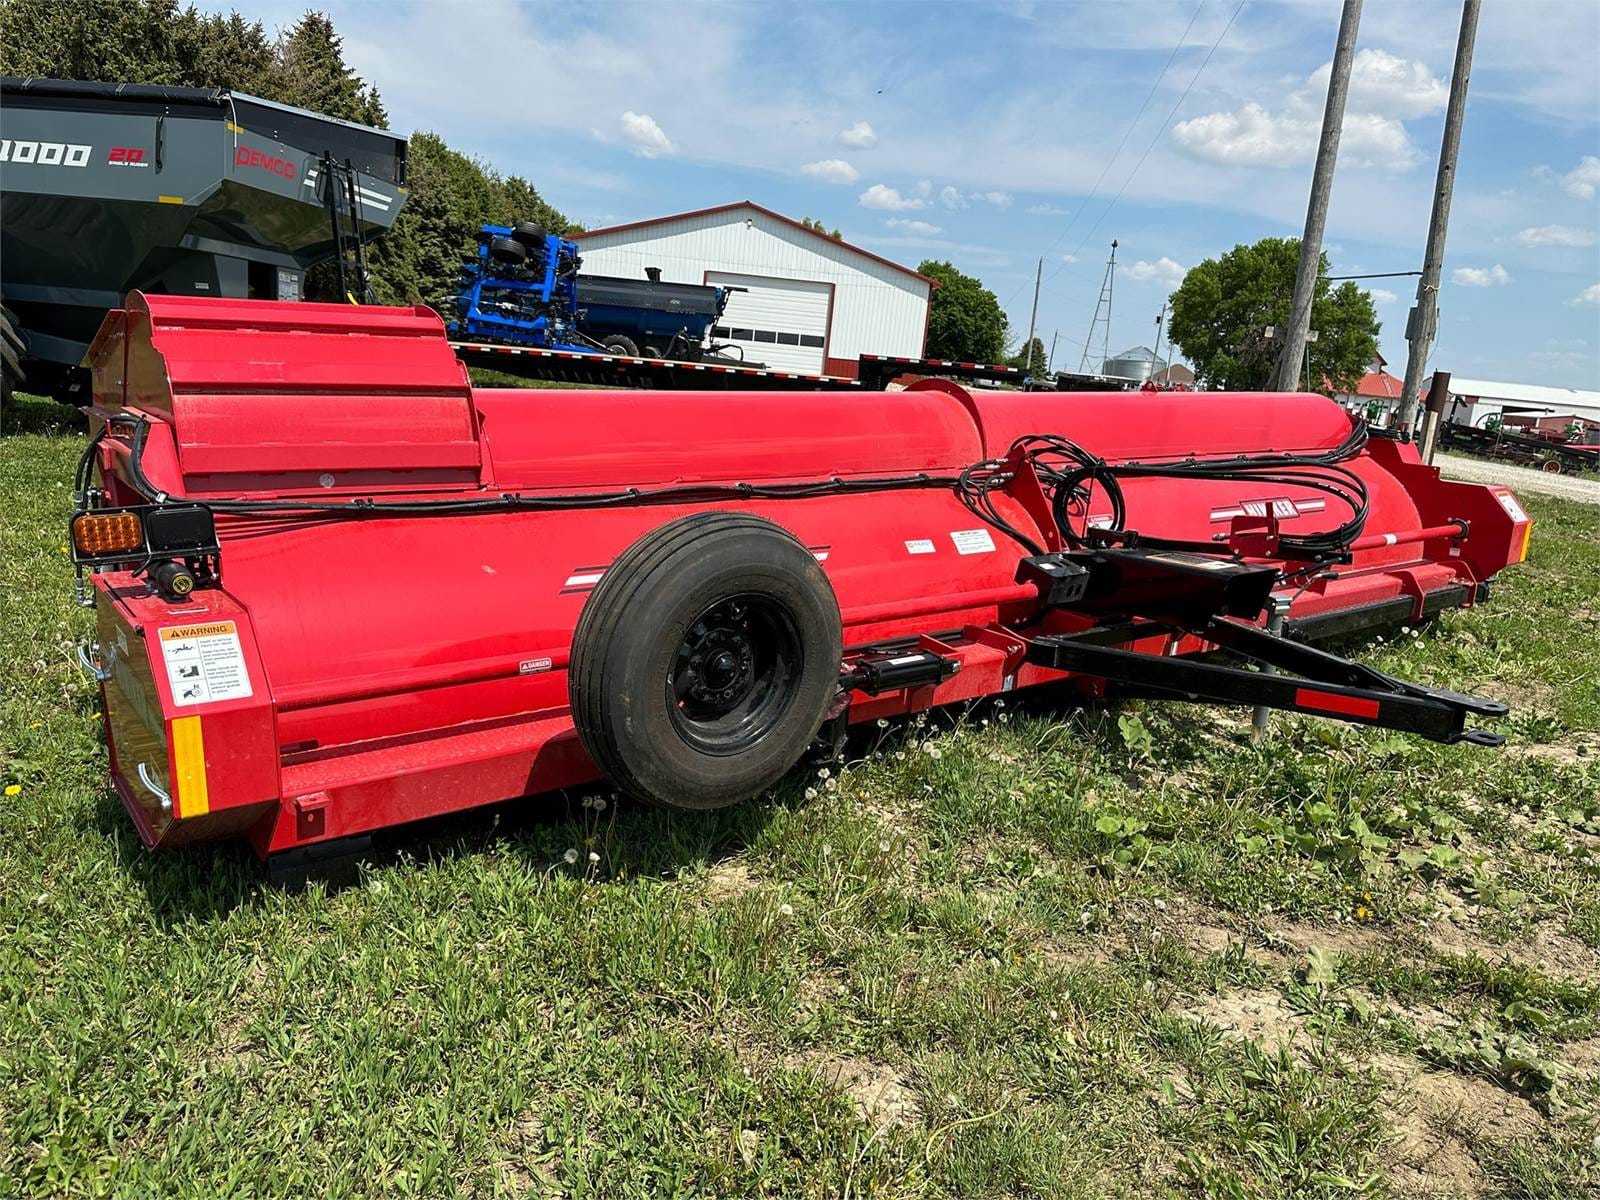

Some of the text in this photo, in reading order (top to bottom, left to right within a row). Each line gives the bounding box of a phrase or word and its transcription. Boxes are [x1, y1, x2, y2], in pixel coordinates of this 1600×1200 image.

[0, 139, 92, 167] 1000
[109, 147, 144, 161] 20
[235, 145, 297, 179] DEMCO
[180, 625, 228, 637] WARNING
